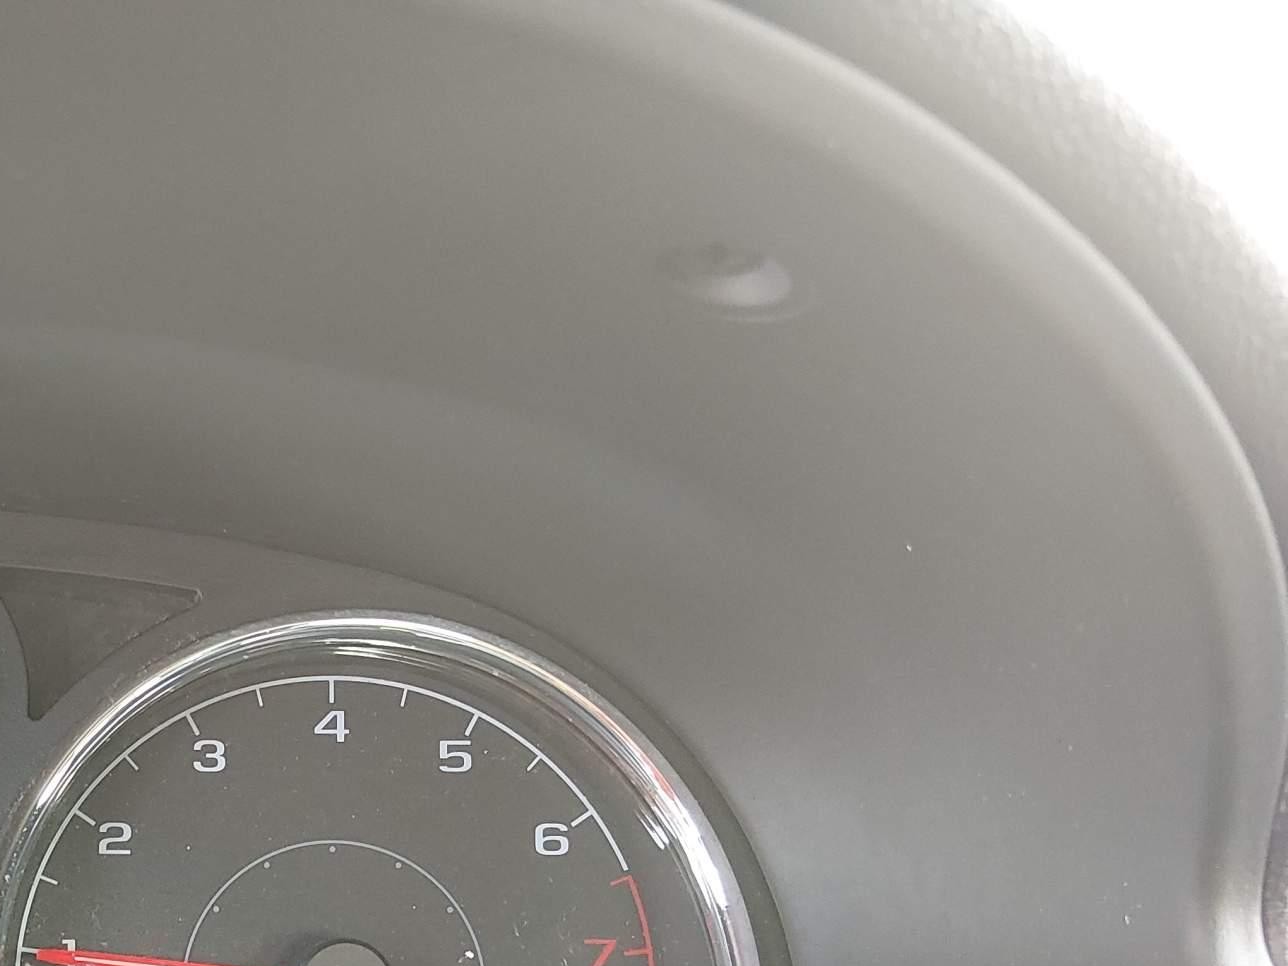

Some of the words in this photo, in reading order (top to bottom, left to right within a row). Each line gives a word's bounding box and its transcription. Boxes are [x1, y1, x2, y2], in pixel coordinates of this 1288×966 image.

[314, 711, 350, 742] 4
[192, 740, 226, 772] 3
[439, 740, 472, 772] 5
[98, 822, 132, 855] 2
[534, 824, 569, 856] 6
